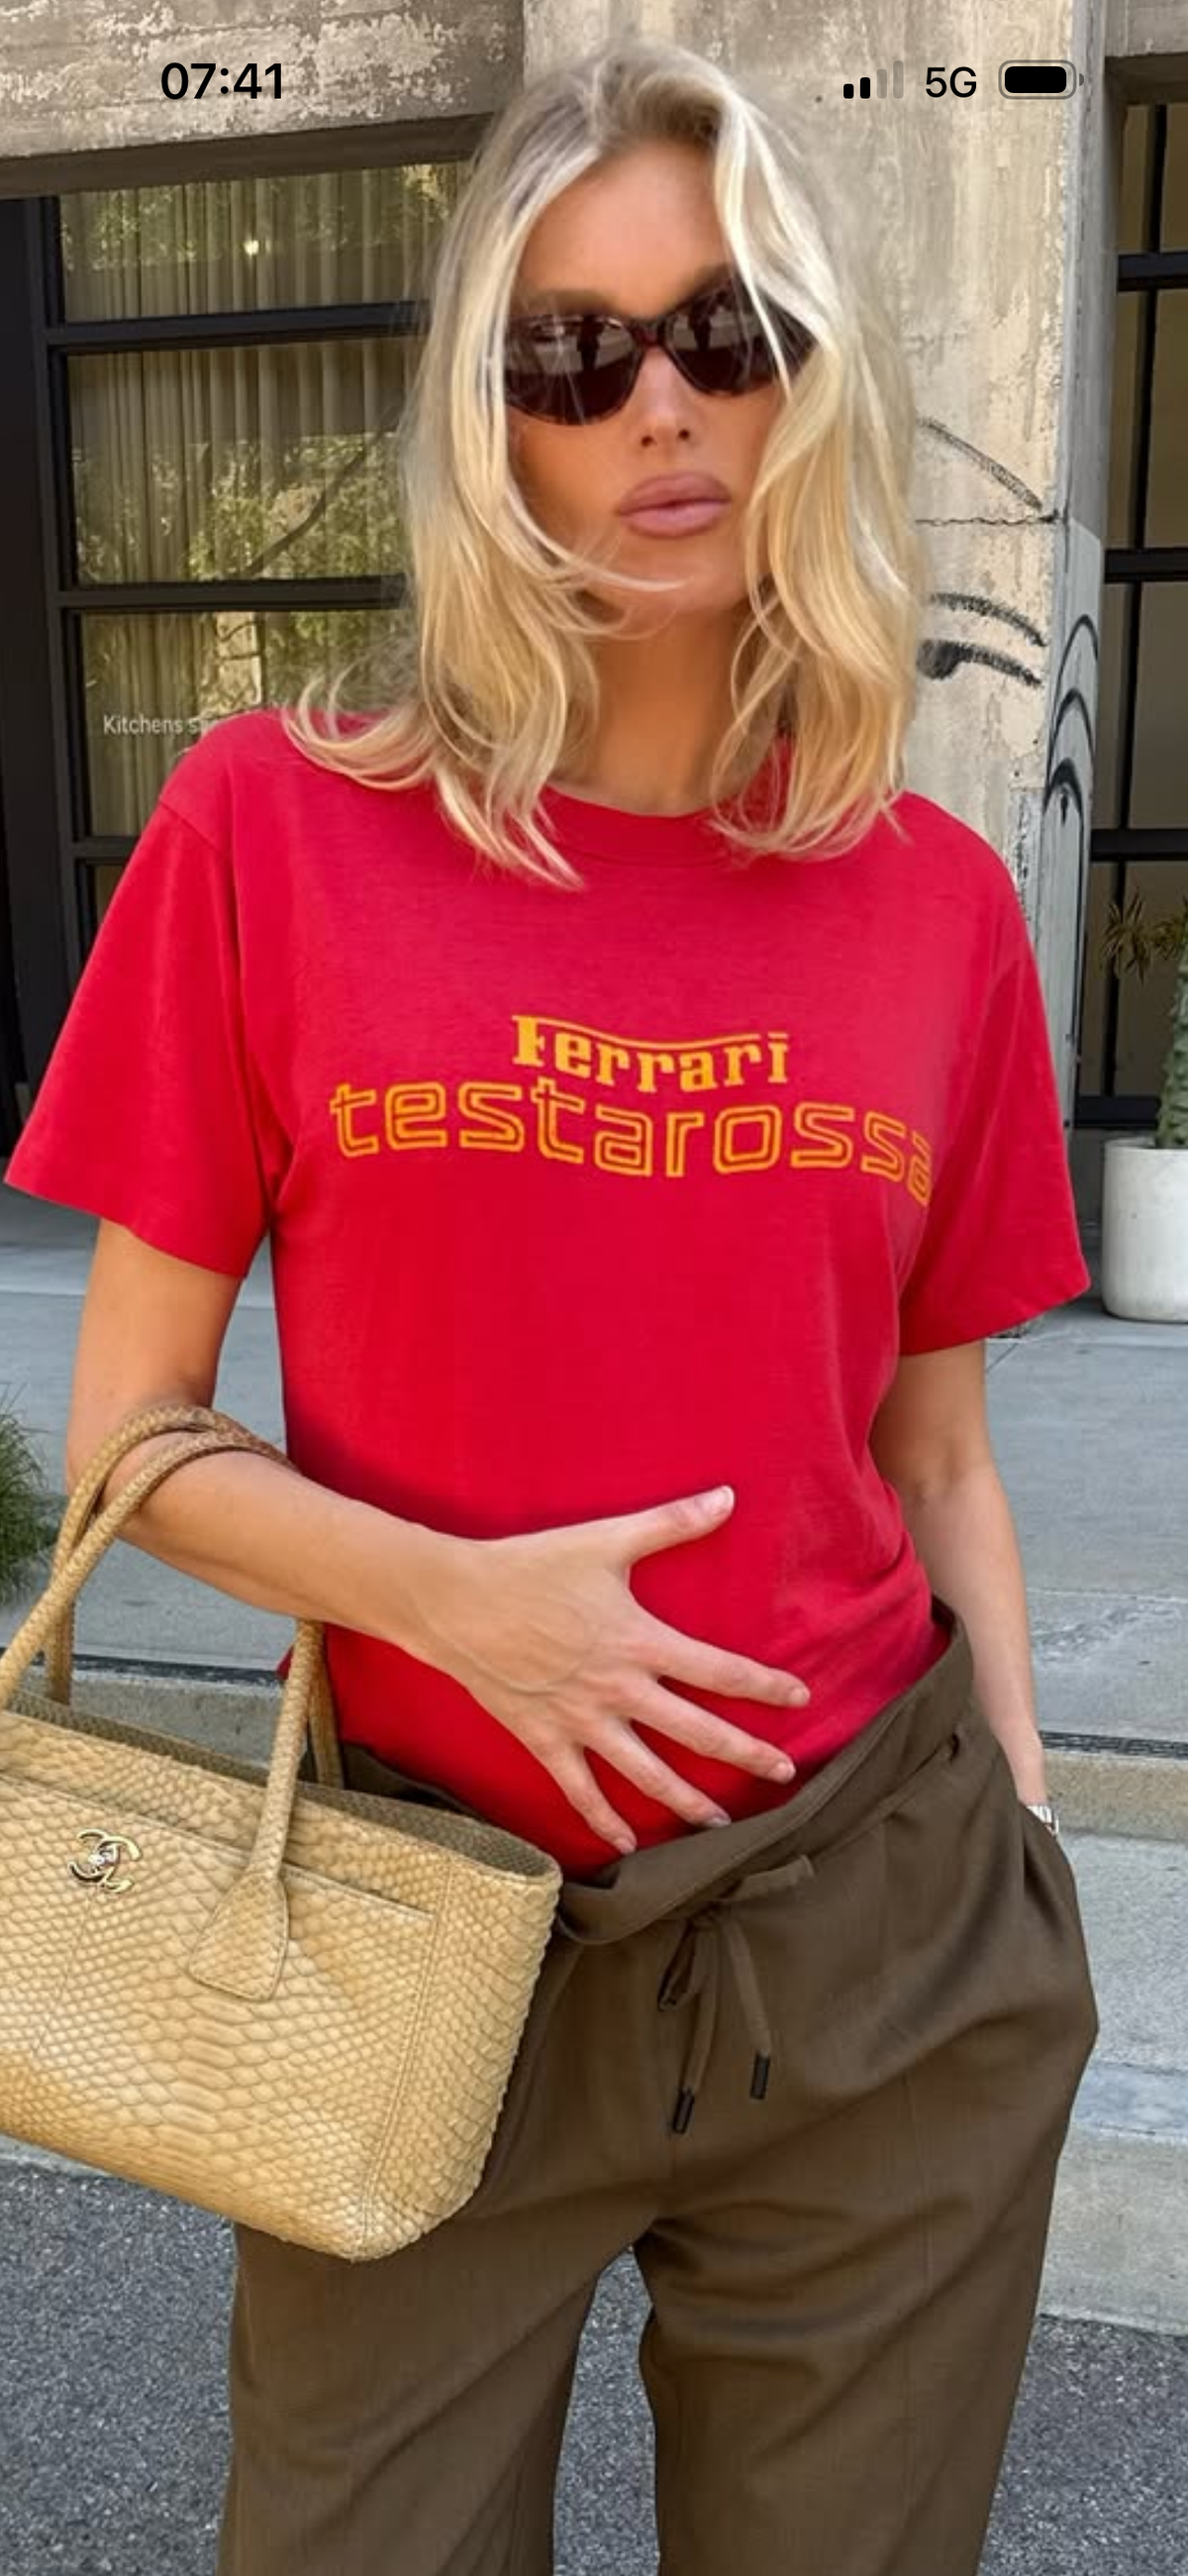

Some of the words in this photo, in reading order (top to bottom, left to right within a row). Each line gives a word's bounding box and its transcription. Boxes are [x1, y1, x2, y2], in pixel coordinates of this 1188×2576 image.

[103, 713, 184, 735] Kitchens
[512, 1014, 791, 1093] Ferrari
[330, 1076, 933, 1206] testarossa
